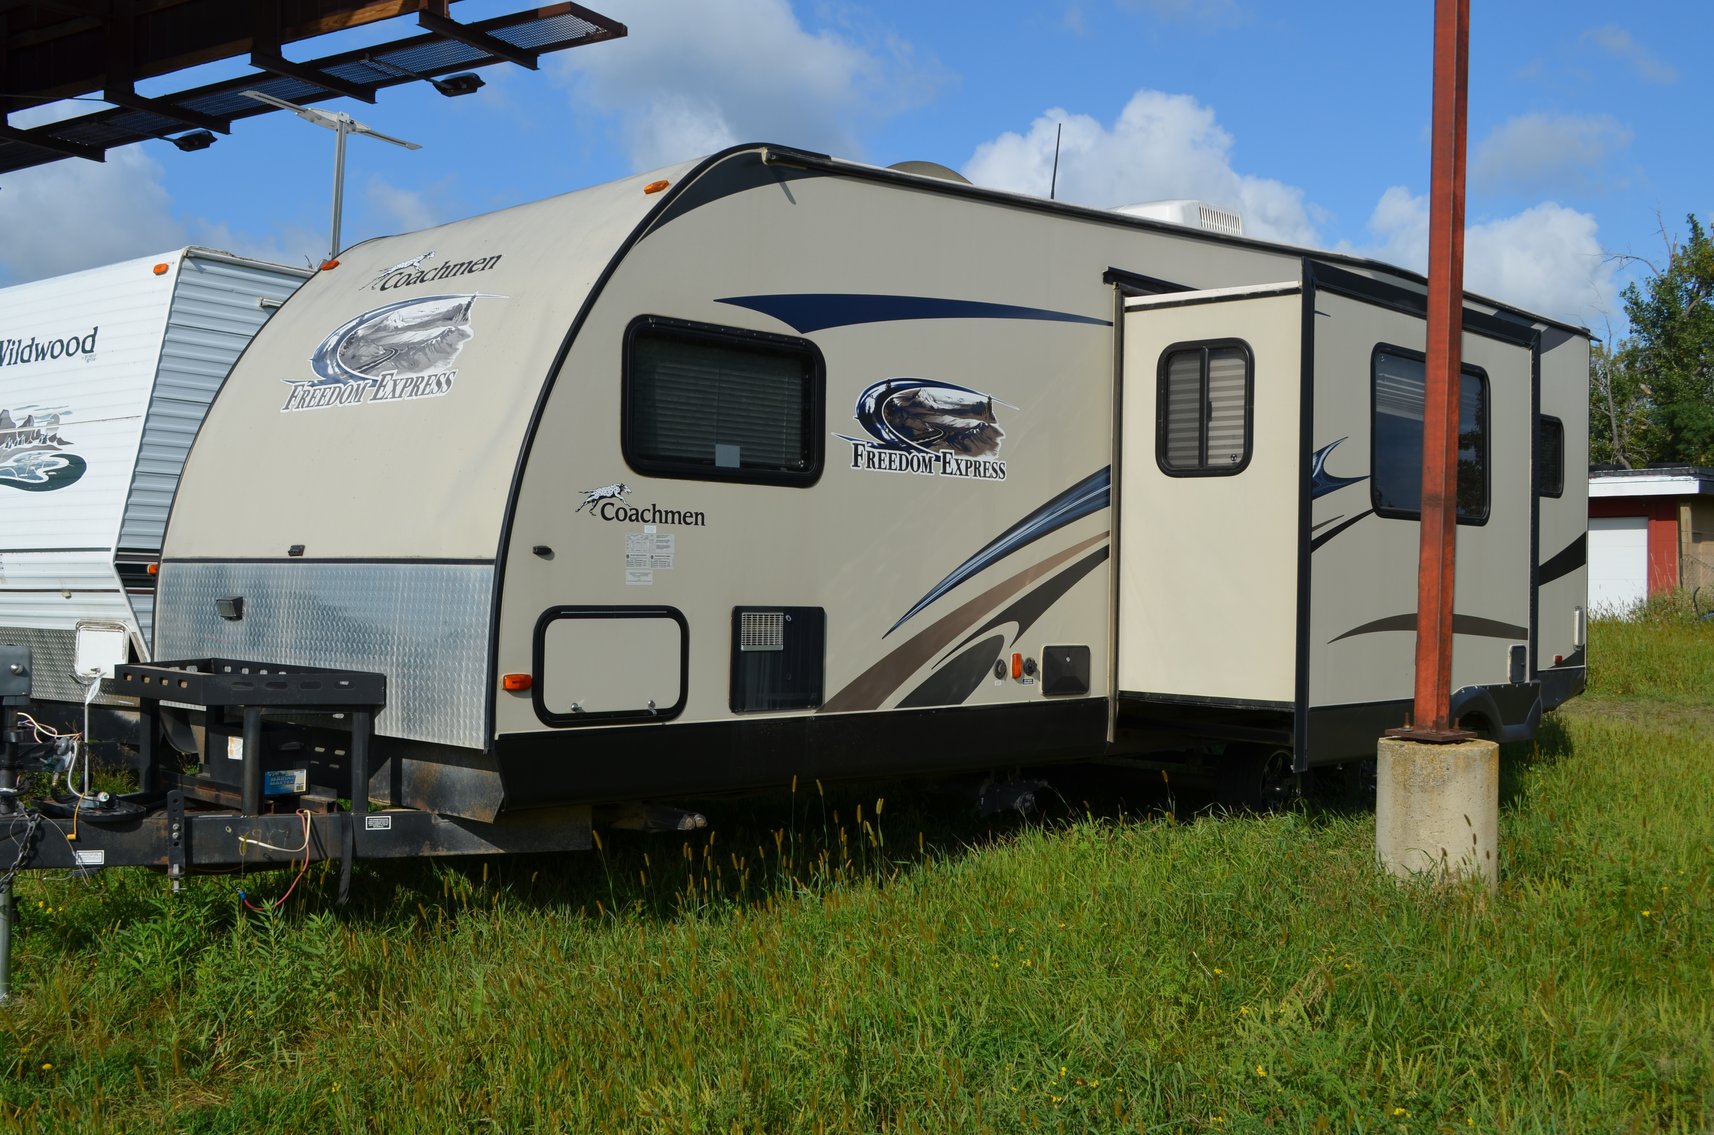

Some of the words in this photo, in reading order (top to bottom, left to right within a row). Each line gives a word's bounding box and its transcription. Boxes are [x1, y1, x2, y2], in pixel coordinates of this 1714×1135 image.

[379, 254, 503, 291] Coachmen
[282, 380, 370, 411] FREEDOM
[369, 370, 457, 401] EXPRESS
[851, 443, 934, 474] FREEDOM
[940, 451, 1006, 480] EXPRESS
[600, 502, 706, 526] Coachmen
